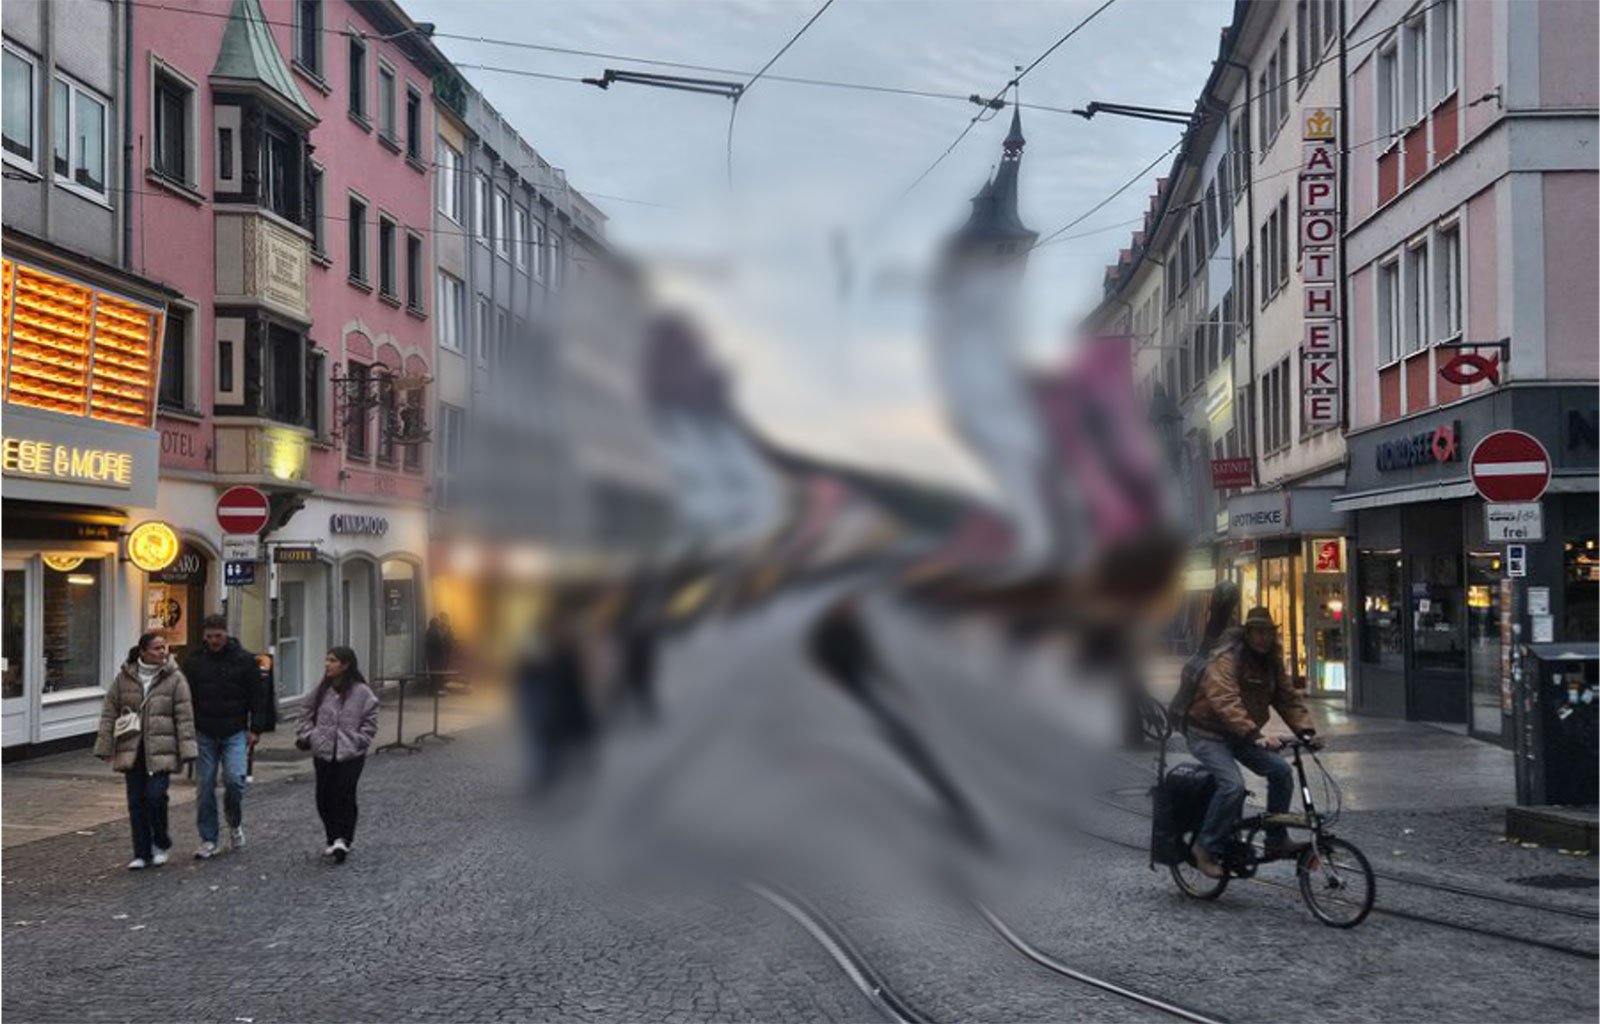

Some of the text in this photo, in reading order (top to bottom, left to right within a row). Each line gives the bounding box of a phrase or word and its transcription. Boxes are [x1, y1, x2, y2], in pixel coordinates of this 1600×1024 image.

[1306, 147, 1334, 420] APOTHEKE
[2, 437, 53, 475] ESE
[70, 447, 133, 484] MORE
[161, 431, 196, 458] OTEL
[1502, 526, 1528, 538] frei
